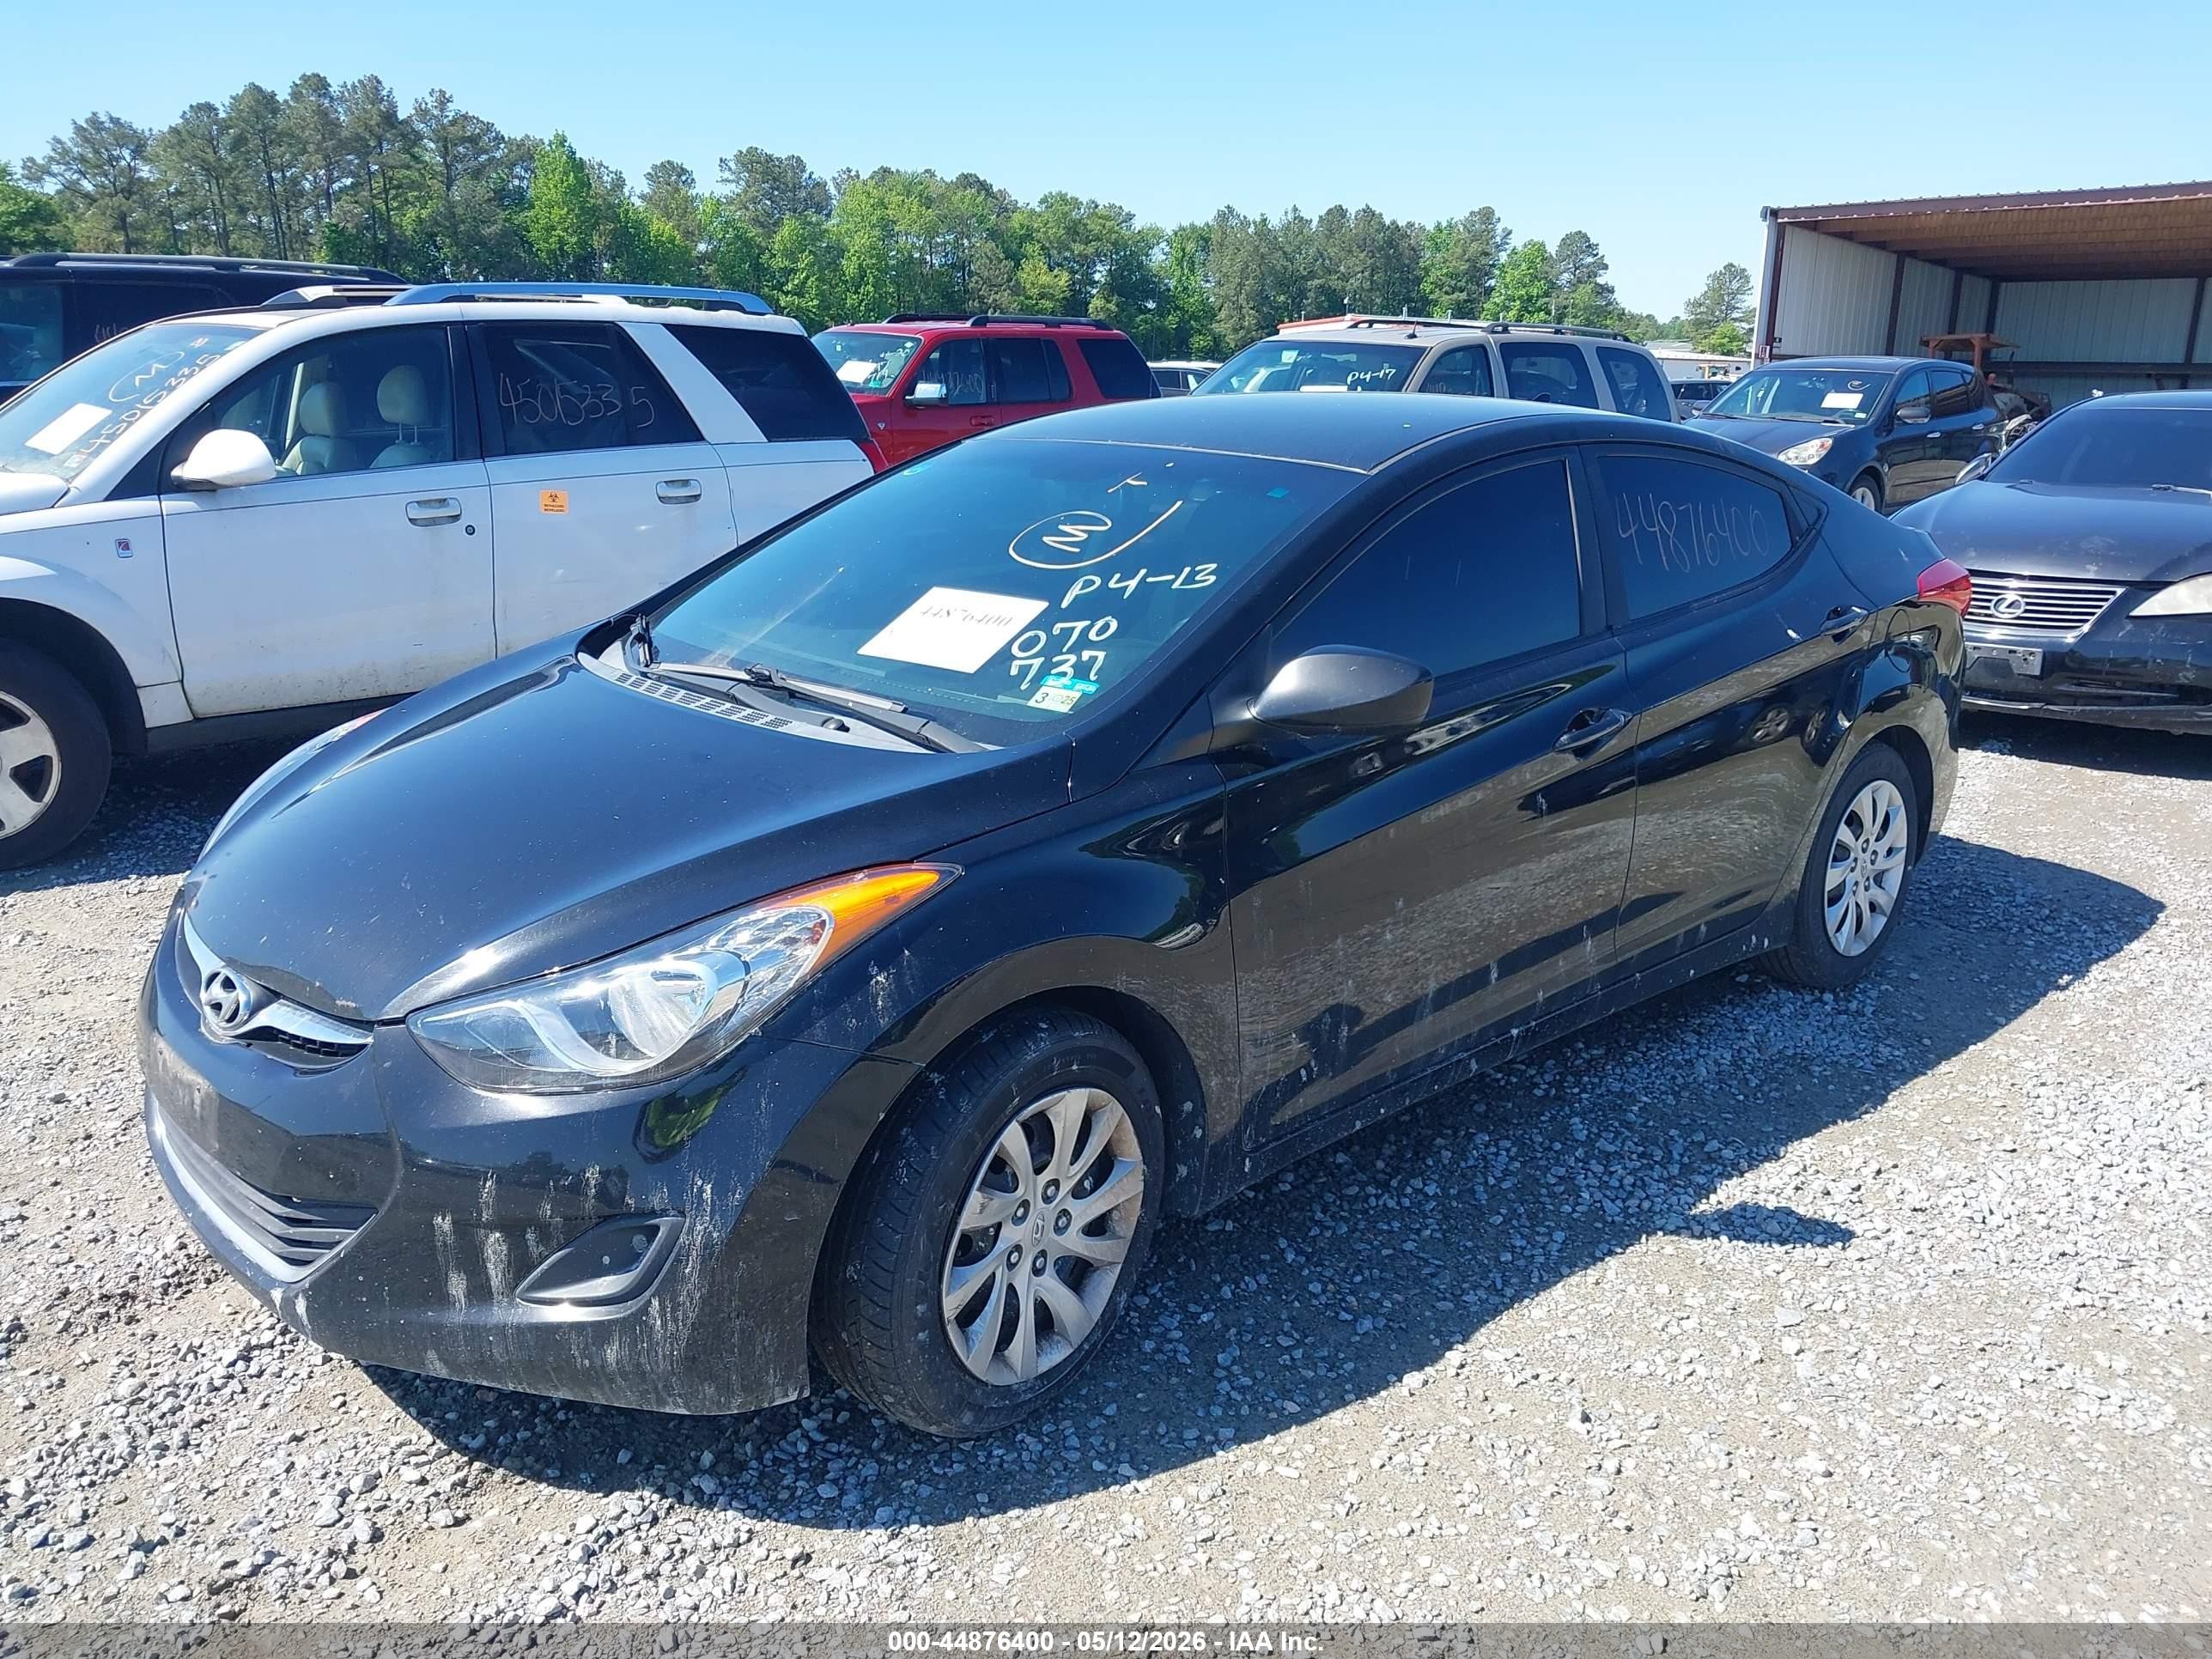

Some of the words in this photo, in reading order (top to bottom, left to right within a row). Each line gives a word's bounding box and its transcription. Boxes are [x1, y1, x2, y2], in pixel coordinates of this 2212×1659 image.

[1615, 492, 1769, 574] 44876400
[1060, 562, 1218, 610] P4-13
[1010, 615, 1119, 659] 070
[1009, 649, 1108, 691] 737
[1035, 692, 1049, 704] 3
